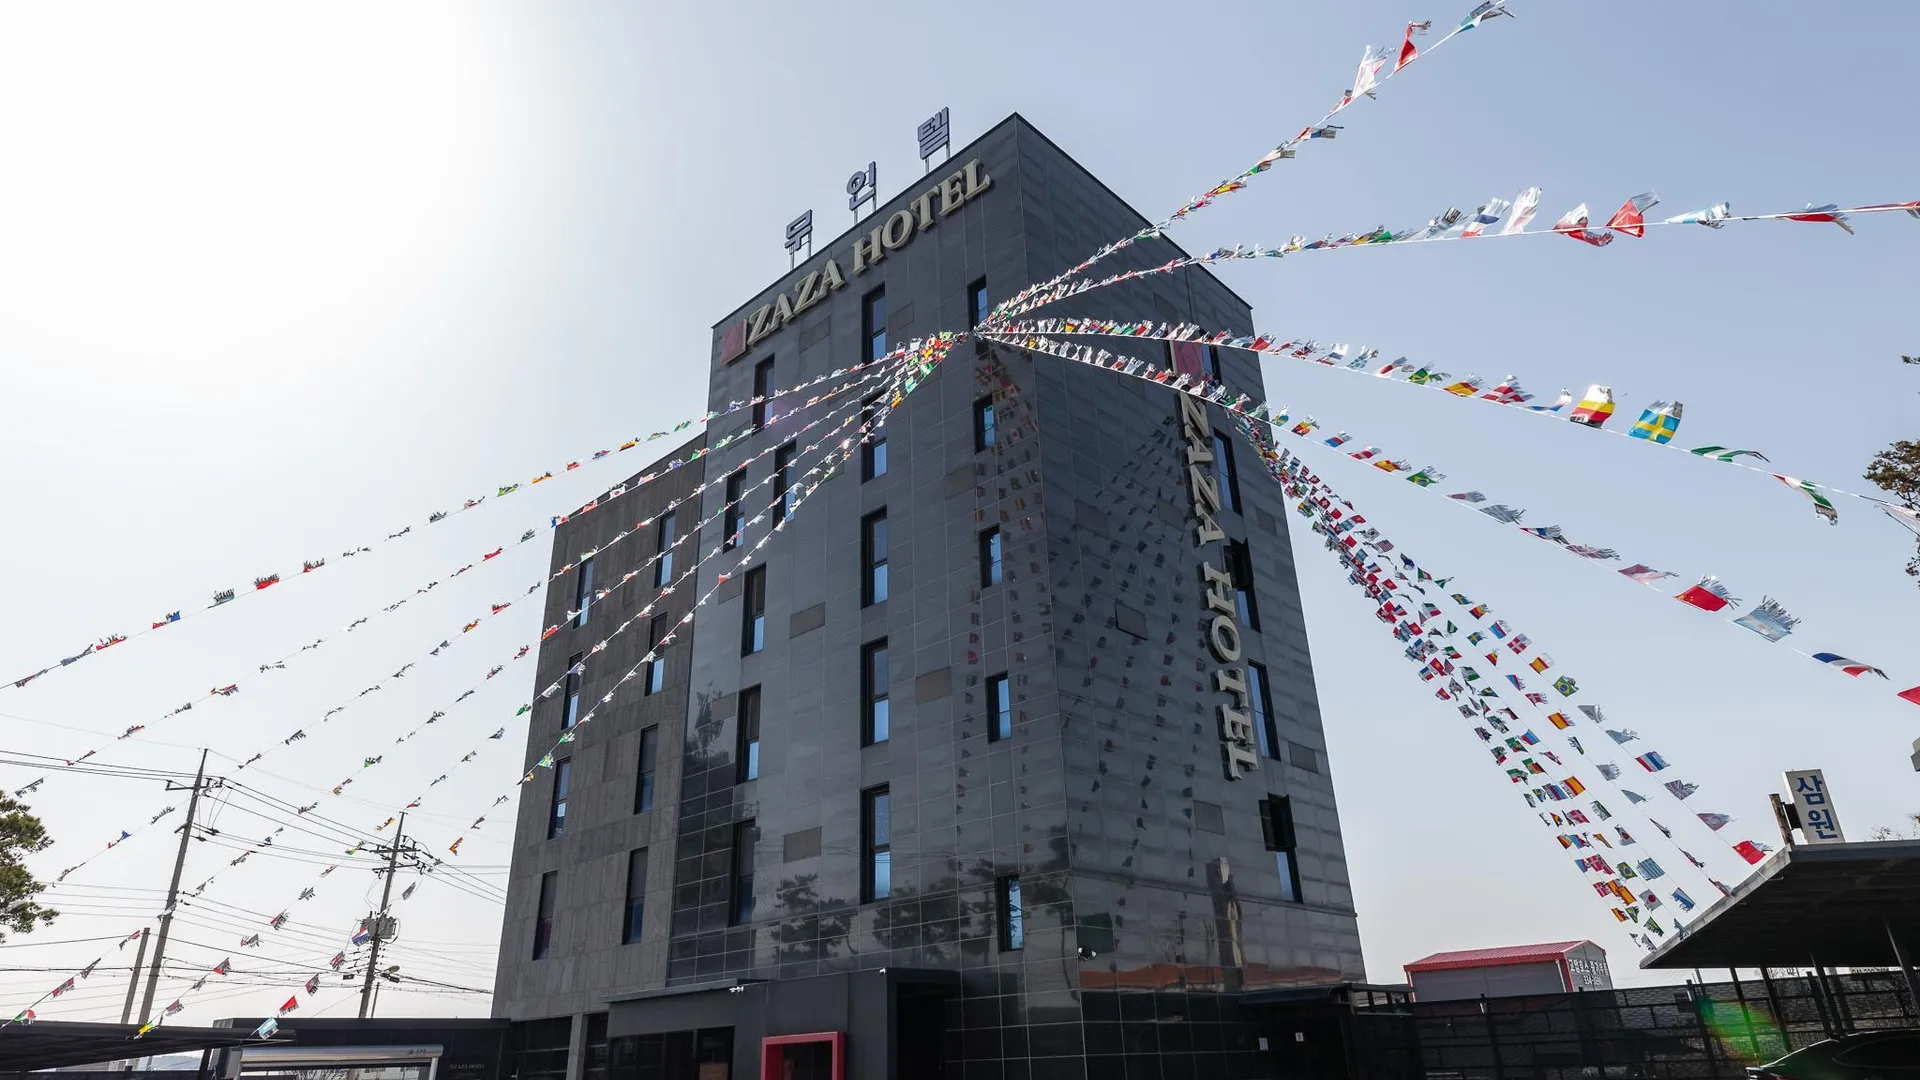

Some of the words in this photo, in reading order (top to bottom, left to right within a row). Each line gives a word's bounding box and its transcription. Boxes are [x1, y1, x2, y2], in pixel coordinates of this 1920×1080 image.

[746, 259, 846, 346] ZAZA
[851, 157, 992, 276] HOTEL
[784, 106, 950, 252] 무인텔
[1179, 391, 1226, 546] ZAZA
[1203, 560, 1259, 780] HOTEL
[1796, 775, 1838, 839] 삼원
